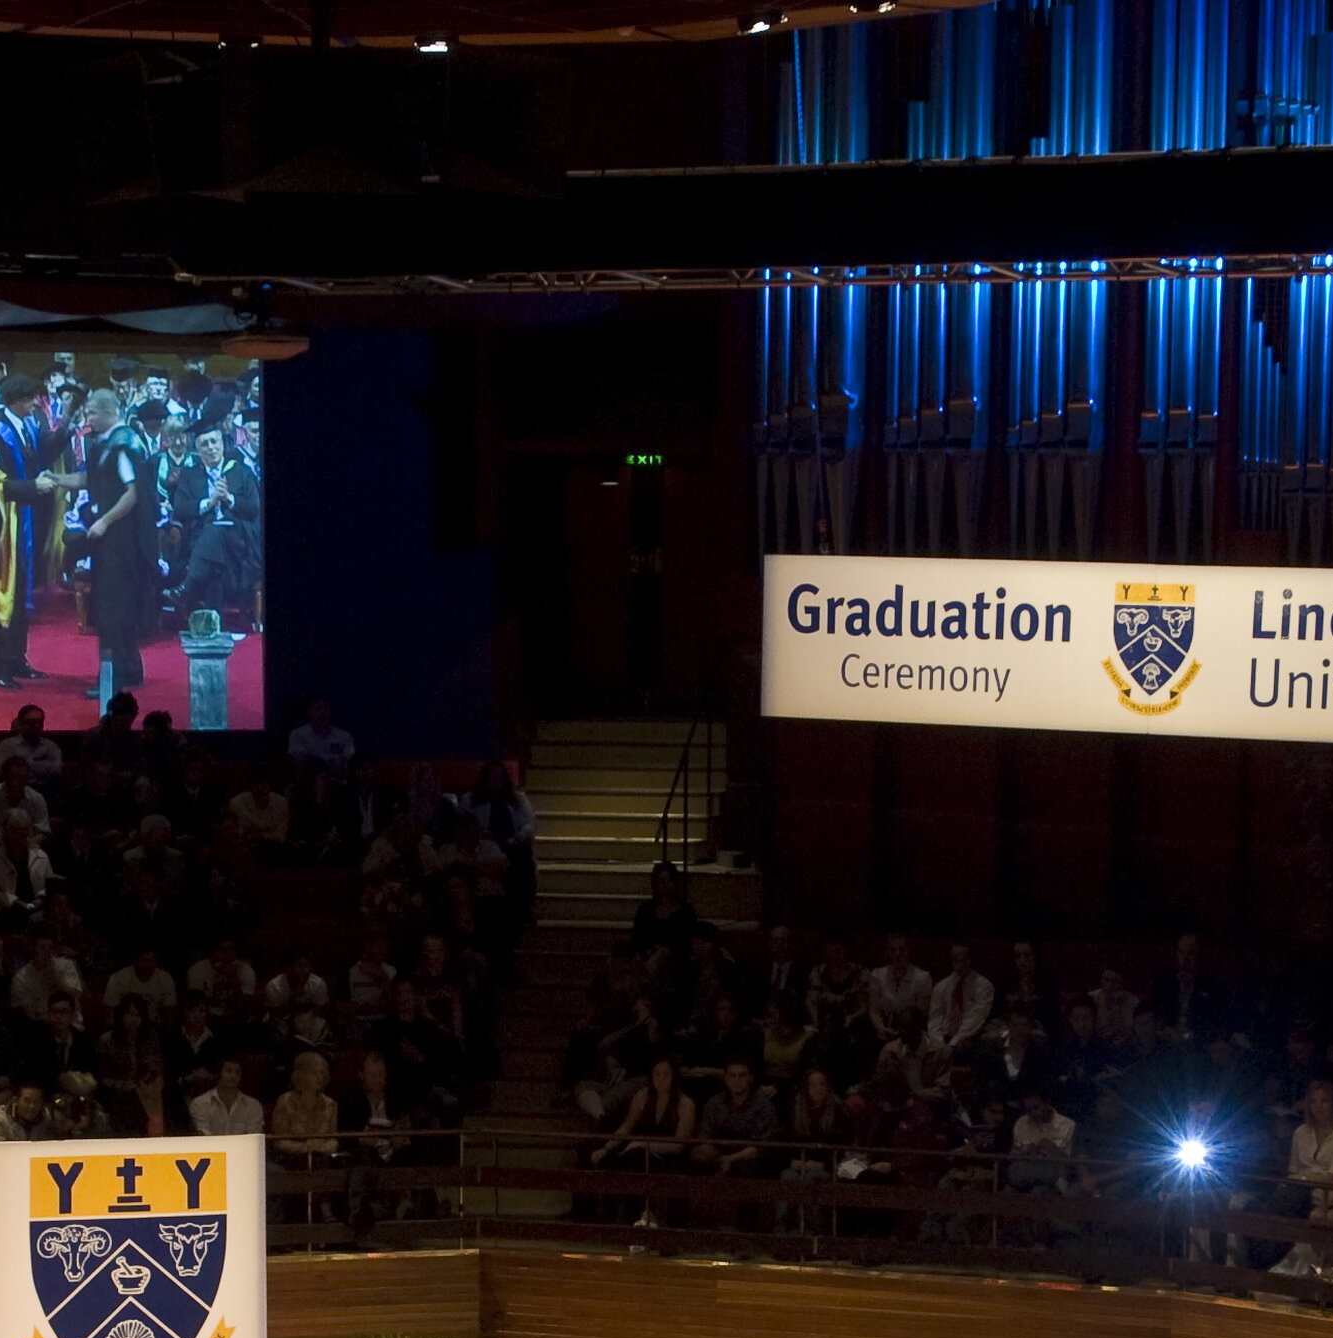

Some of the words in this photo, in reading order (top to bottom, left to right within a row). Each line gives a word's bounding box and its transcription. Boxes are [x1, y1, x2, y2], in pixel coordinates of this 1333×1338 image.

[627, 455, 662, 464] EXIT
[787, 583, 1072, 643] Graduation
[840, 653, 1011, 703] Ceremony
